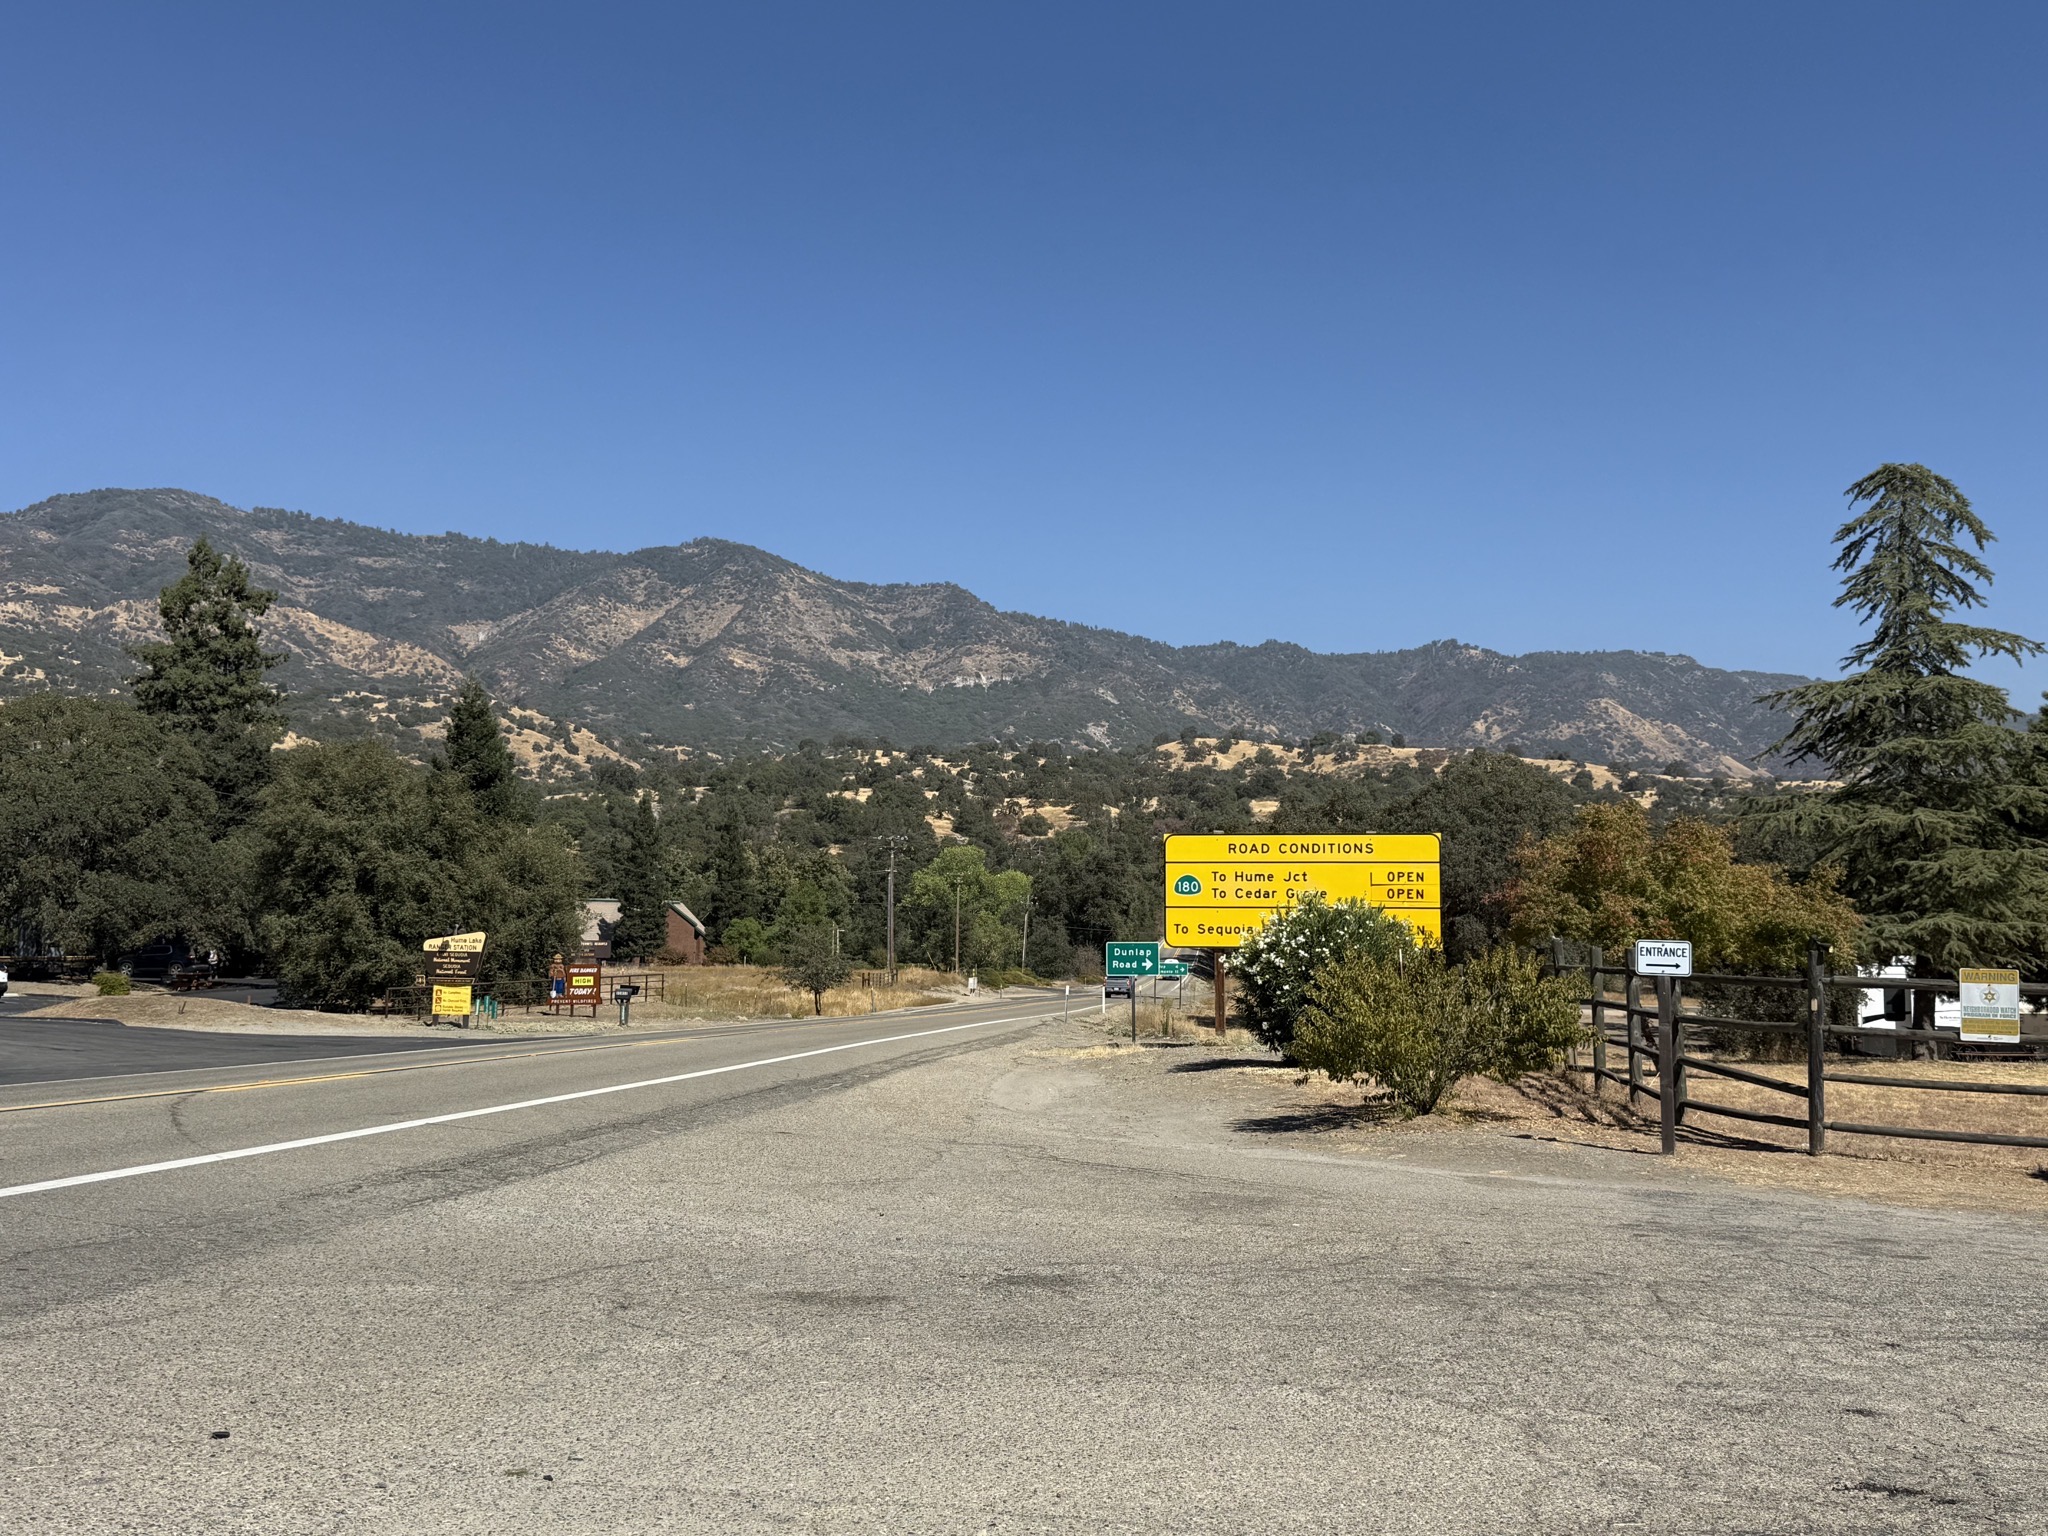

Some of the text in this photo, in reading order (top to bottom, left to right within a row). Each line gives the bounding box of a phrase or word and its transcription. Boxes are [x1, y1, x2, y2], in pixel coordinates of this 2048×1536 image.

[1228, 843, 1375, 854] ROAD CONDITIONS
[1211, 871, 1308, 882] To Hume Jct
[1387, 871, 1425, 883] OPEN
[1177, 881, 1199, 893] 180
[1211, 888, 1227, 899] To
[1235, 888, 1278, 899] Cedar
[1387, 888, 1425, 900] OPEN
[1174, 923, 1254, 936] To Sequoia
[1114, 948, 1152, 957] Dunlap
[1640, 946, 1688, 958] ENTRANCE
[1112, 961, 1138, 969] Road
[1964, 972, 2016, 982] WARNING
